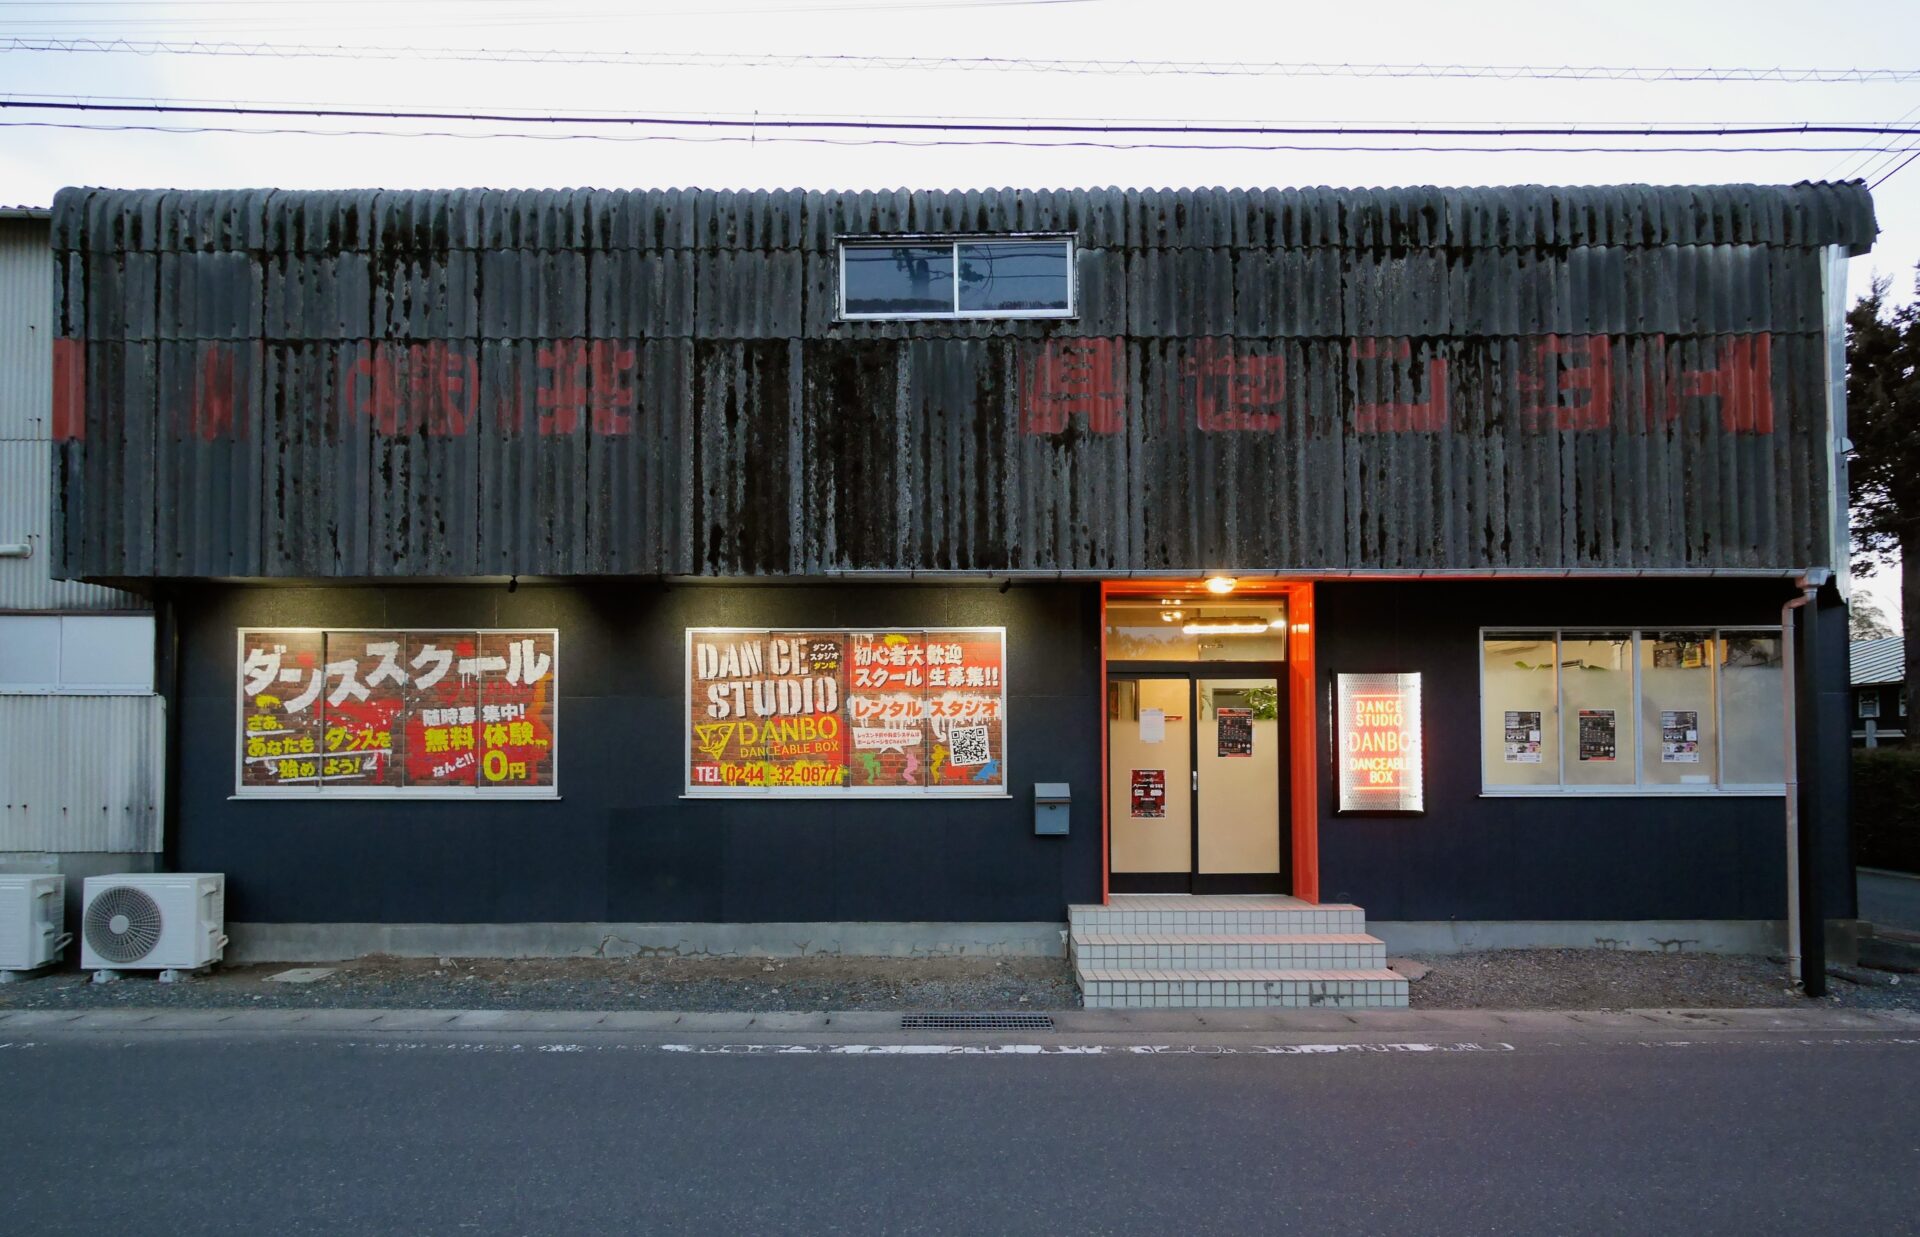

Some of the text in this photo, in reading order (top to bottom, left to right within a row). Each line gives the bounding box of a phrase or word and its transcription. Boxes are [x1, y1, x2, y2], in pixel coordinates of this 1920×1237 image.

[812, 643, 836, 652] ダンス
[855, 644, 963, 667] 初心者大歓迎
[697, 638, 810, 681] DANCE
[809, 652, 840, 661] スタジオ
[244, 639, 551, 714] ダンススクール
[707, 676, 840, 719] STUDIO
[855, 699, 999, 718] レンタルスタジオ
[1356, 700, 1402, 713] DANCE
[1356, 713, 1404, 727] STUDIO
[739, 716, 838, 746] DANBO
[1349, 731, 1412, 752] DANBO
[1350, 757, 1413, 770] DANCEABLE
[696, 766, 722, 782] TEL
[726, 766, 838, 783] 0244-32-0877
[1370, 770, 1394, 784] BOX
